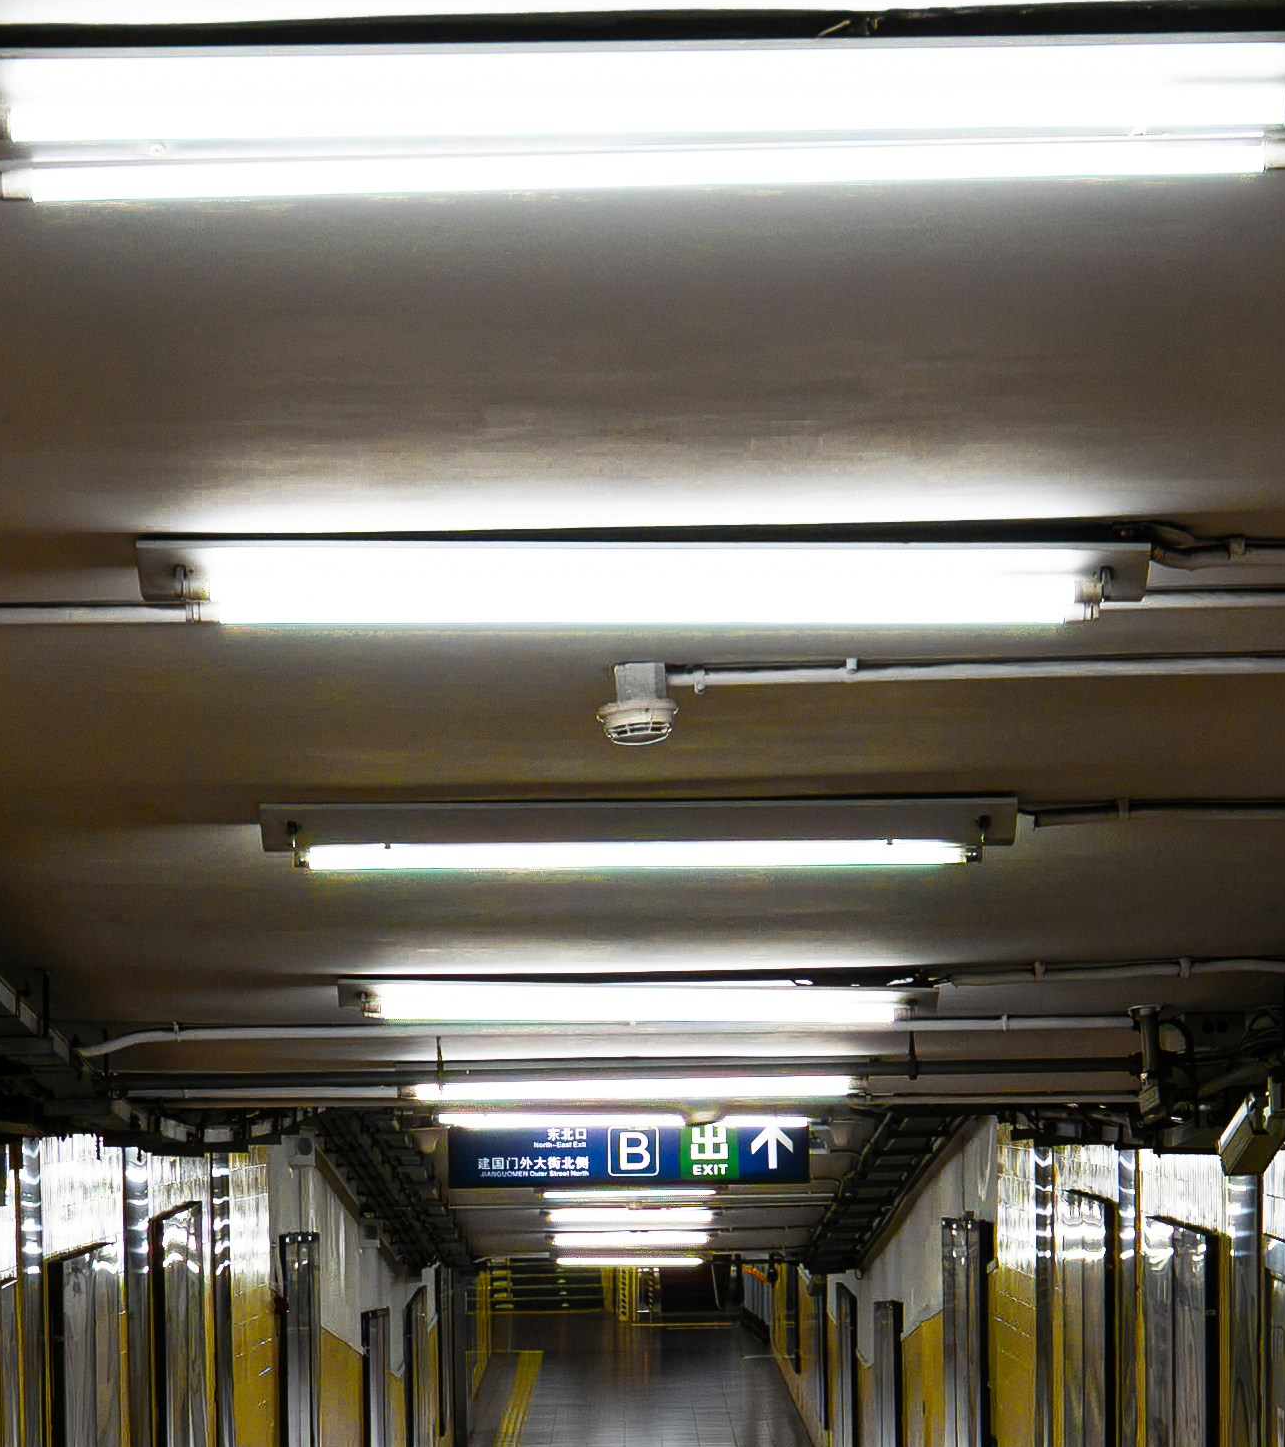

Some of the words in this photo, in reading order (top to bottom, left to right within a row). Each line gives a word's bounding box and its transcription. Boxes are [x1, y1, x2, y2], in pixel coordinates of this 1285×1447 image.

[547, 1128, 587, 1140] 东北口
[691, 1124, 728, 1160] 出
[619, 1131, 651, 1170] B
[477, 1156, 589, 1170] 建国门外大街北侧
[692, 1163, 728, 1176] EXIT
